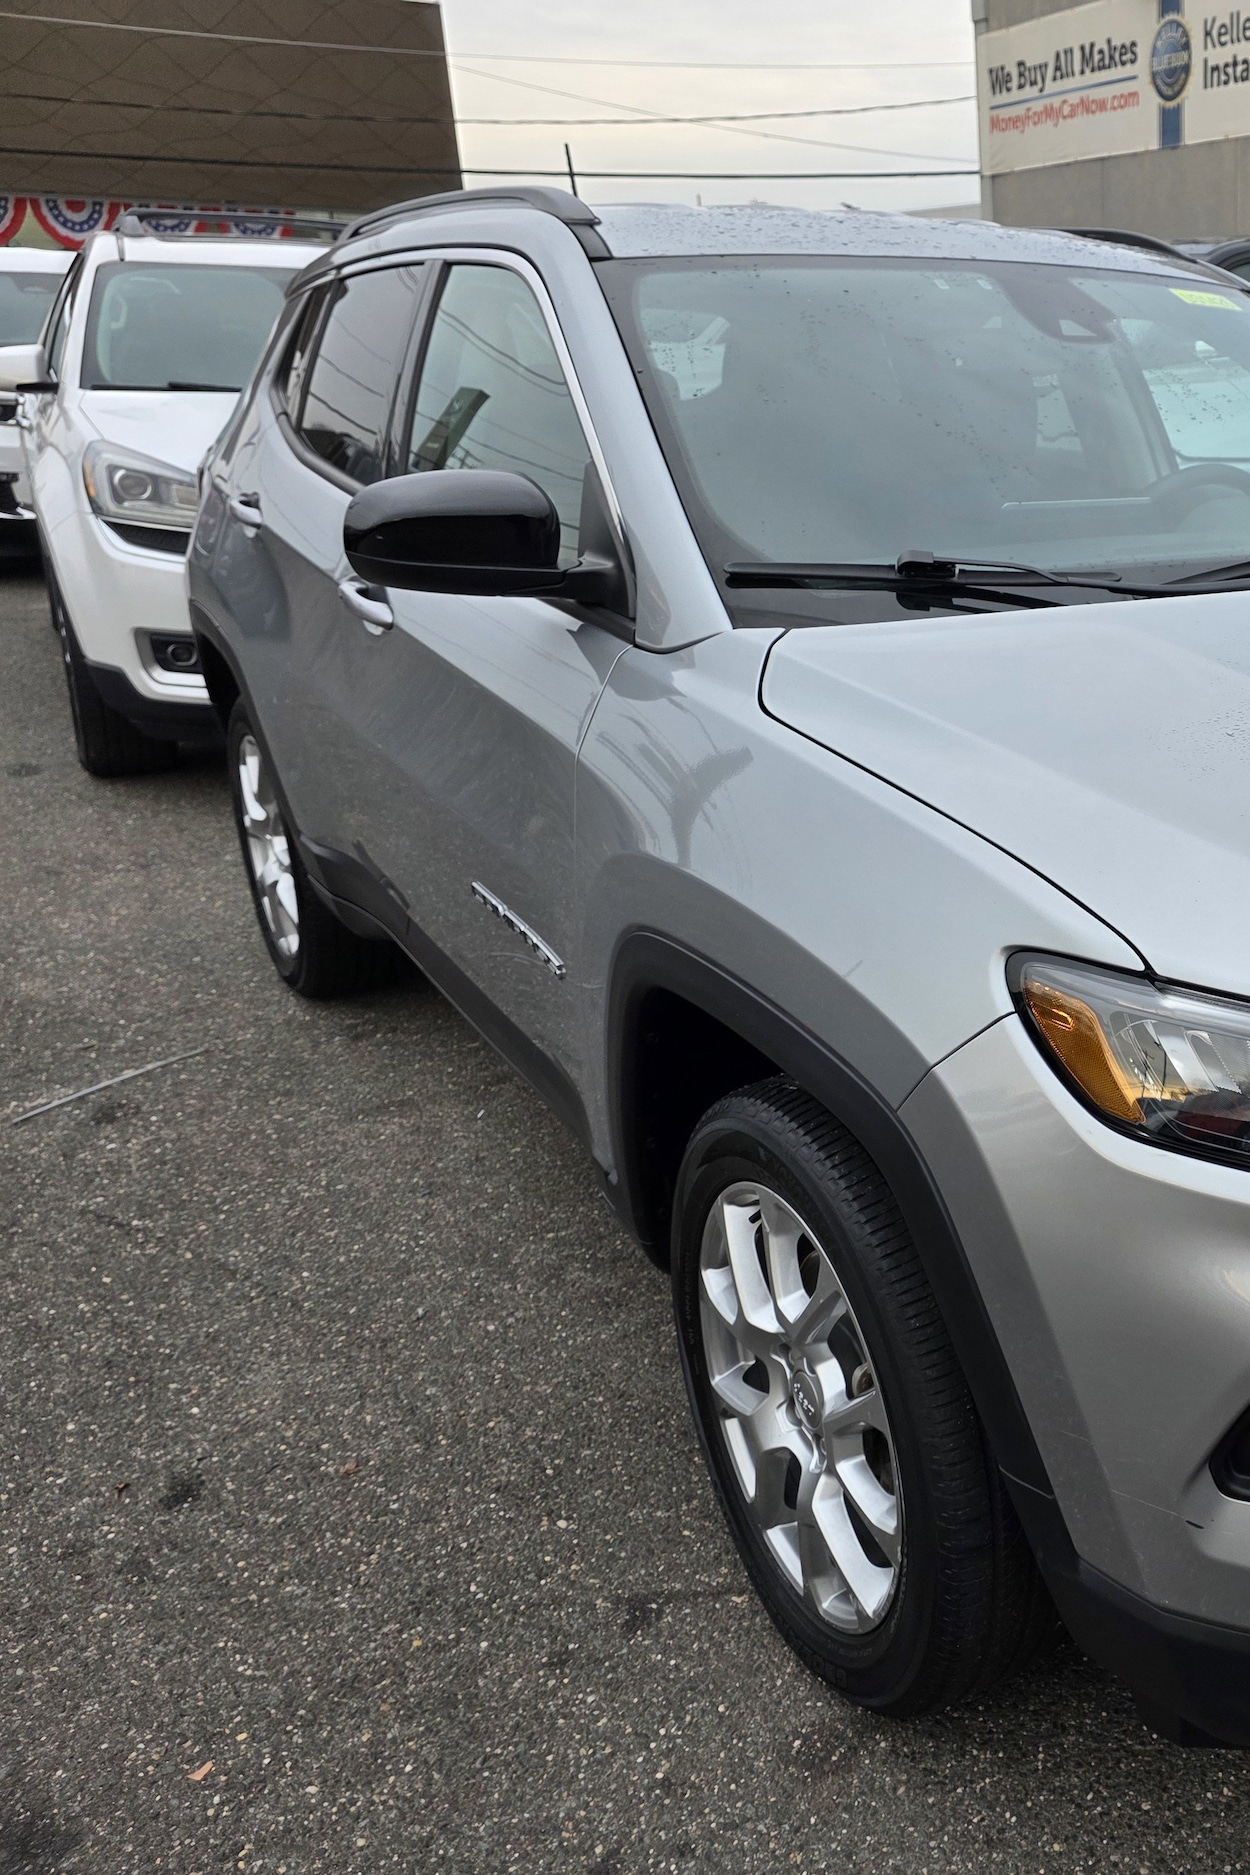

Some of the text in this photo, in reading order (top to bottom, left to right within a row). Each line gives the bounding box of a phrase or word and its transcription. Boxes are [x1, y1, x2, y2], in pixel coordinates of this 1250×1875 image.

[989, 37, 1138, 96] We Buy All Makes
[989, 91, 1140, 133] MoneyForMyCarNow.com
